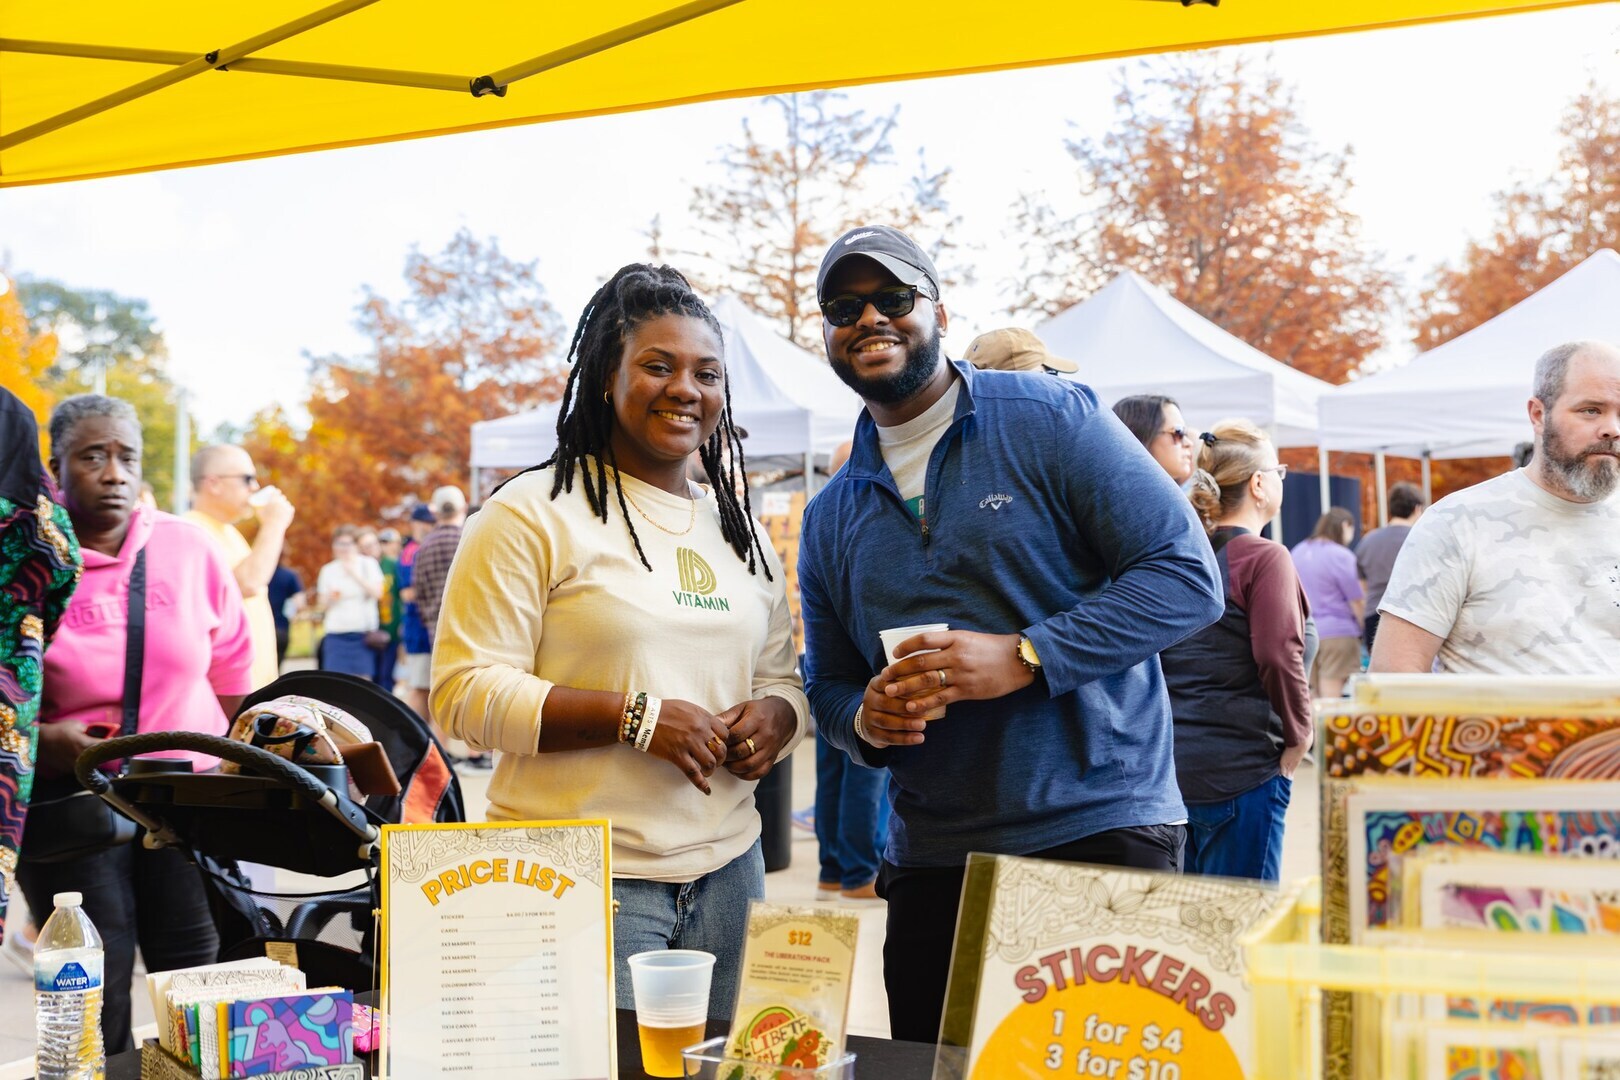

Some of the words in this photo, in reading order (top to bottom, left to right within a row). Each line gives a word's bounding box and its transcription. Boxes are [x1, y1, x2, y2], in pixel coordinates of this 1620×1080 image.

[979, 493, 1013, 508] Callaway
[672, 590, 730, 612] VITAMIN
[420, 858, 508, 906] PRICE
[513, 860, 576, 900] LIST
[787, 929, 813, 947] $12
[763, 950, 775, 959] THE
[775, 952, 812, 963] LIBERATION
[812, 955, 832, 964] PACK
[56, 976, 88, 987] WATER
[1014, 944, 1236, 1031] STICKERS
[1052, 1009, 1066, 1036] 1
[1084, 1012, 1129, 1046] for
[1141, 1021, 1184, 1055] $4
[1044, 1042, 1064, 1070] 3
[1076, 1047, 1123, 1079] for
[1127, 1055, 1181, 1080] $10
